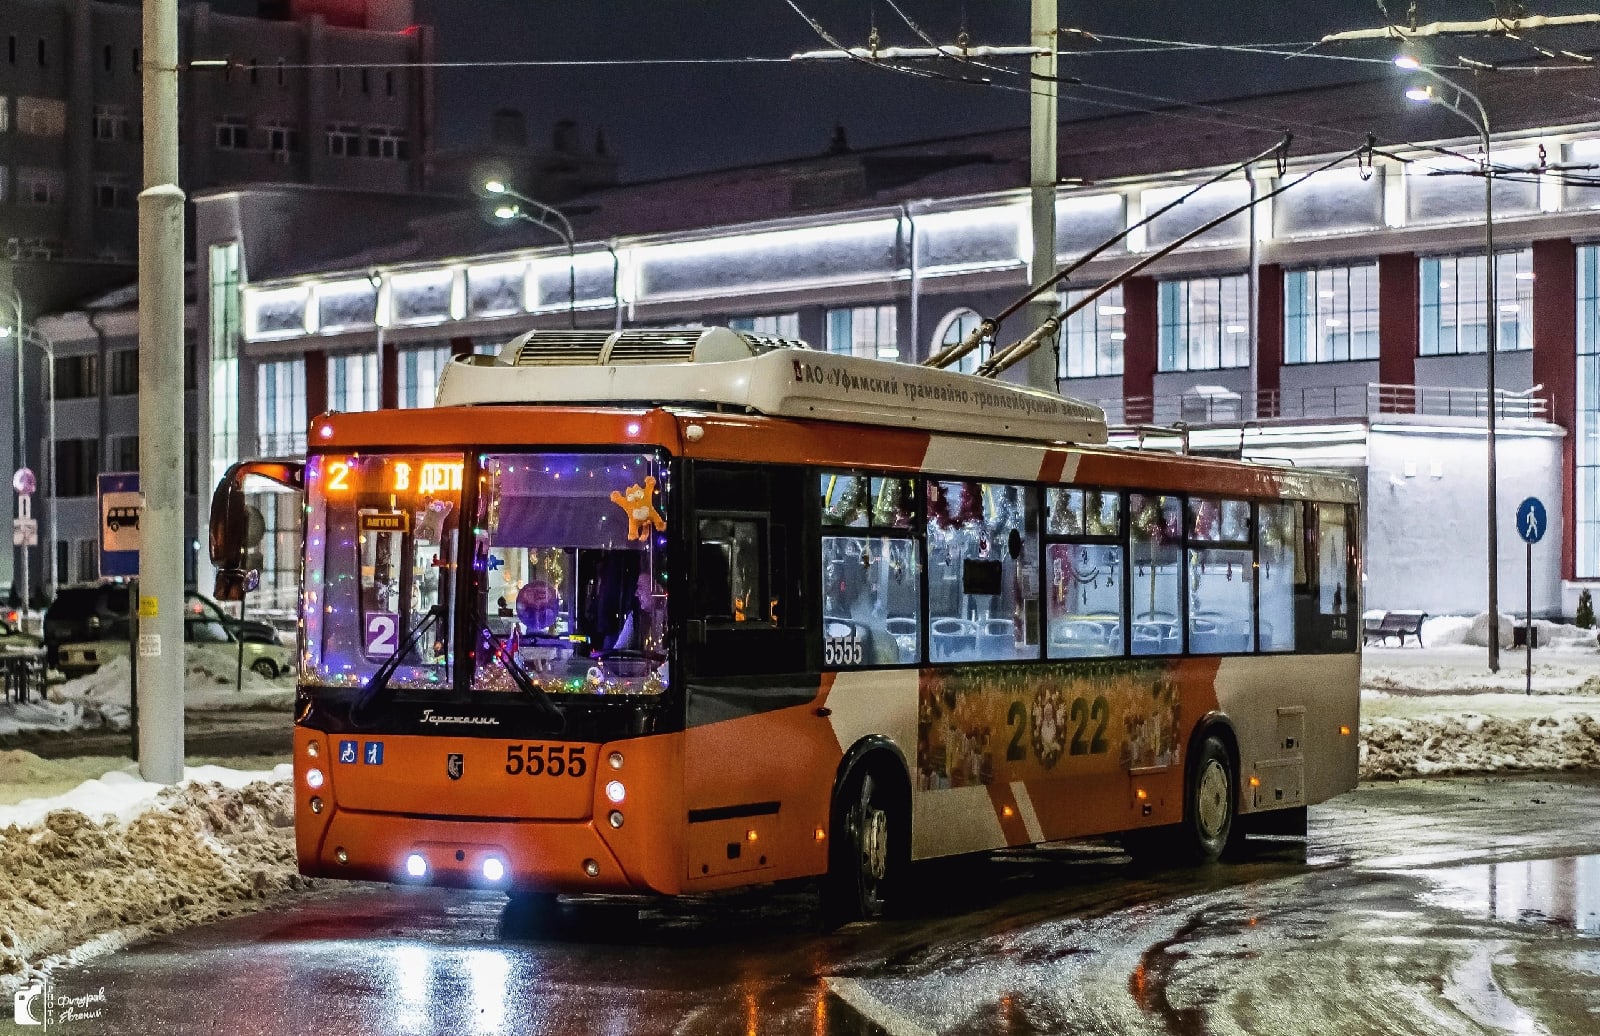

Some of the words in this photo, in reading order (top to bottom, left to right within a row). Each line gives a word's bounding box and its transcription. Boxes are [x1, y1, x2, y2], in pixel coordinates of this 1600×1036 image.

[805, 364, 824, 384] АО
[827, 368, 898, 393] «Уфимский
[328, 462, 349, 490] 2
[395, 462, 409, 490] В
[368, 616, 395, 654] 2
[825, 636, 862, 665] 5555
[420, 709, 500, 725] Горожанин
[505, 744, 587, 777] 5555
